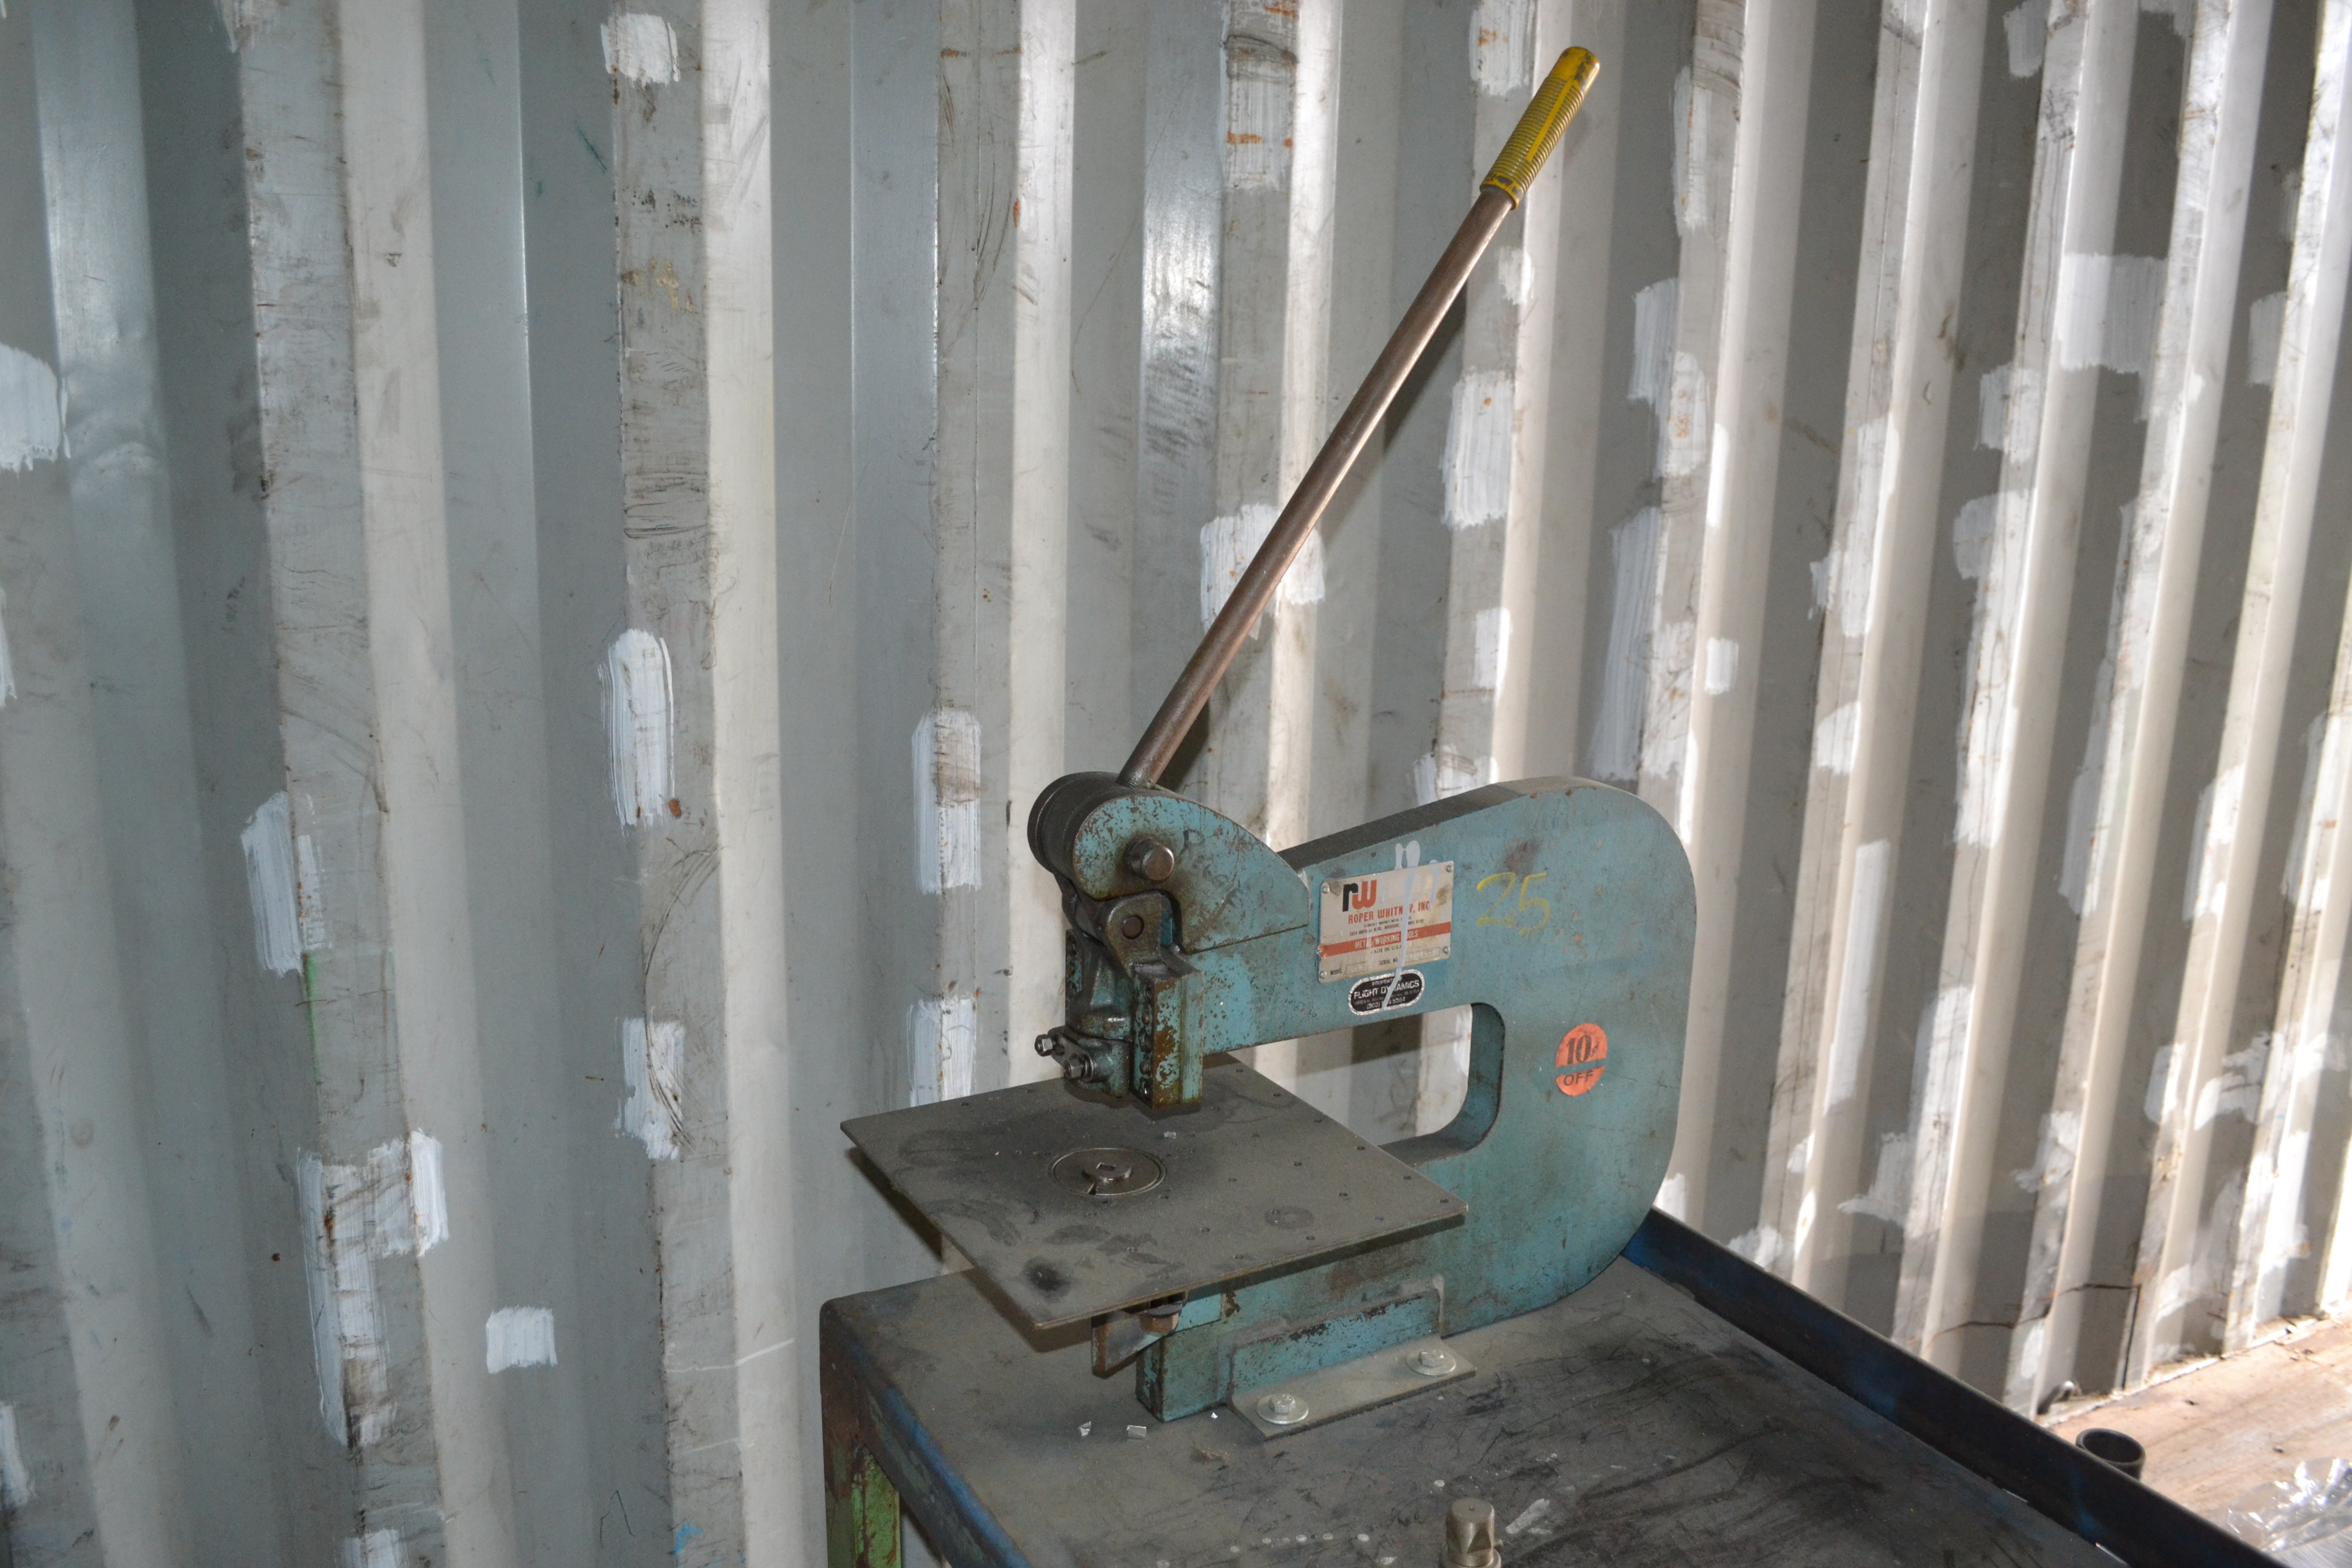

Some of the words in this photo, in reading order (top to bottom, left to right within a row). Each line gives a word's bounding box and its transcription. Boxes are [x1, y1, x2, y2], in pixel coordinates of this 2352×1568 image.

[1476, 871, 1550, 936] 25
[1349, 911, 1374, 924] ROPER
[1378, 904, 1415, 919] WHITNY,
[1354, 987, 1379, 999] FLIGHT
[1381, 979, 1419, 994] DYAMICS
[1371, 977, 1394, 986] PROPERT
[1563, 1069, 1594, 1086] OFF
